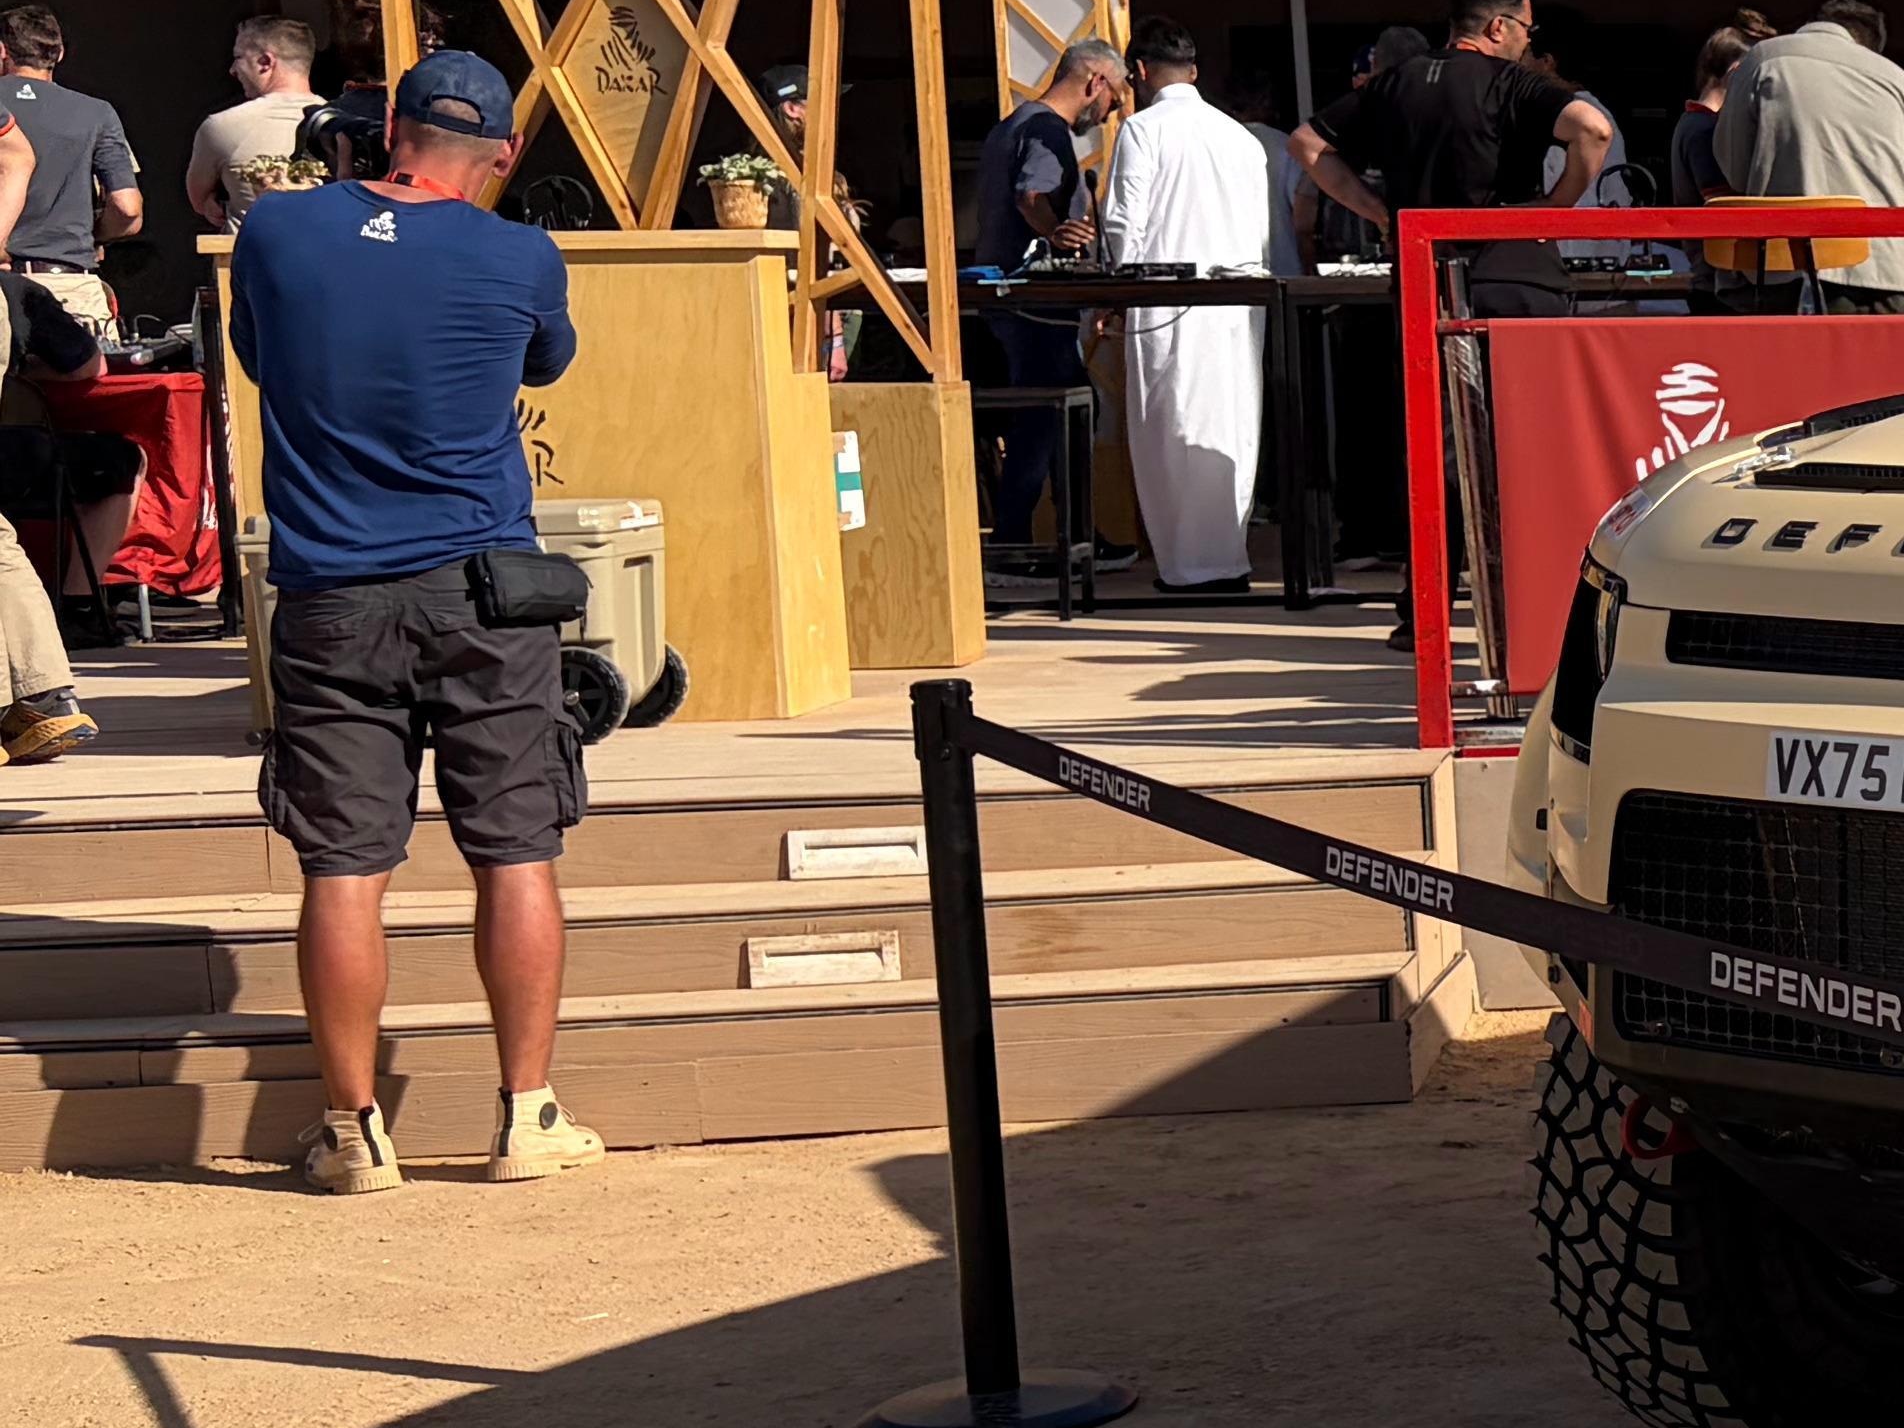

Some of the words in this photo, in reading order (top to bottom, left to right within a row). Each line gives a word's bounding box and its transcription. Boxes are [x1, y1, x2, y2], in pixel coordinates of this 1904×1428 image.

[595, 66, 668, 96] DAKAR
[1059, 755, 1151, 812] DEFENDER
[1774, 736, 1890, 803] VX75
[1325, 845, 1454, 913] DEFENDER
[1710, 952, 1902, 1032] DEFENDER
